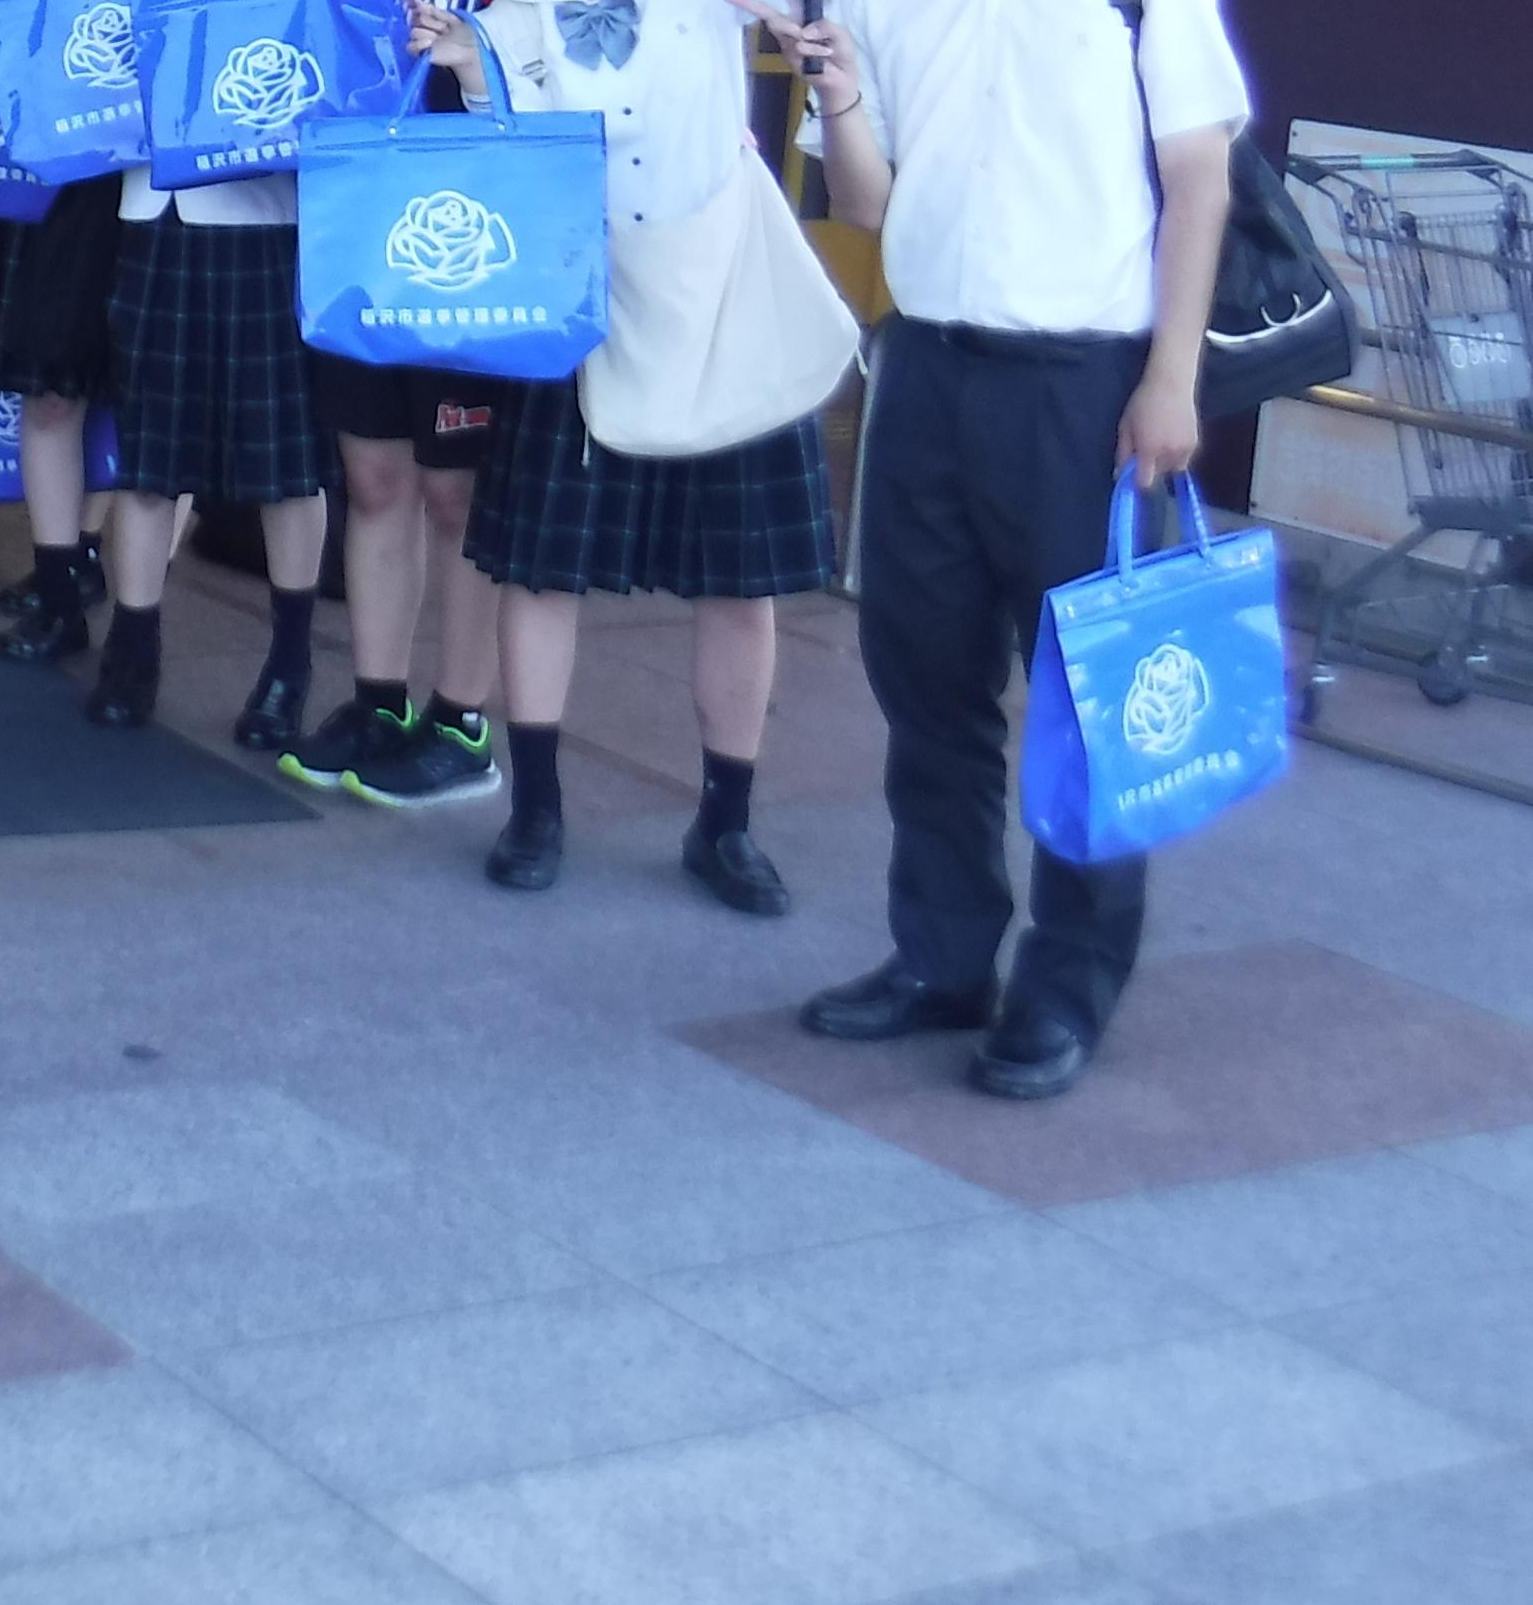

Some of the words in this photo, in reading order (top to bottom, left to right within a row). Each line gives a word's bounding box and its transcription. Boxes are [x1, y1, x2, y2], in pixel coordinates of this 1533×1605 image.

[195, 139, 300, 171] 稲沢市選挙管
